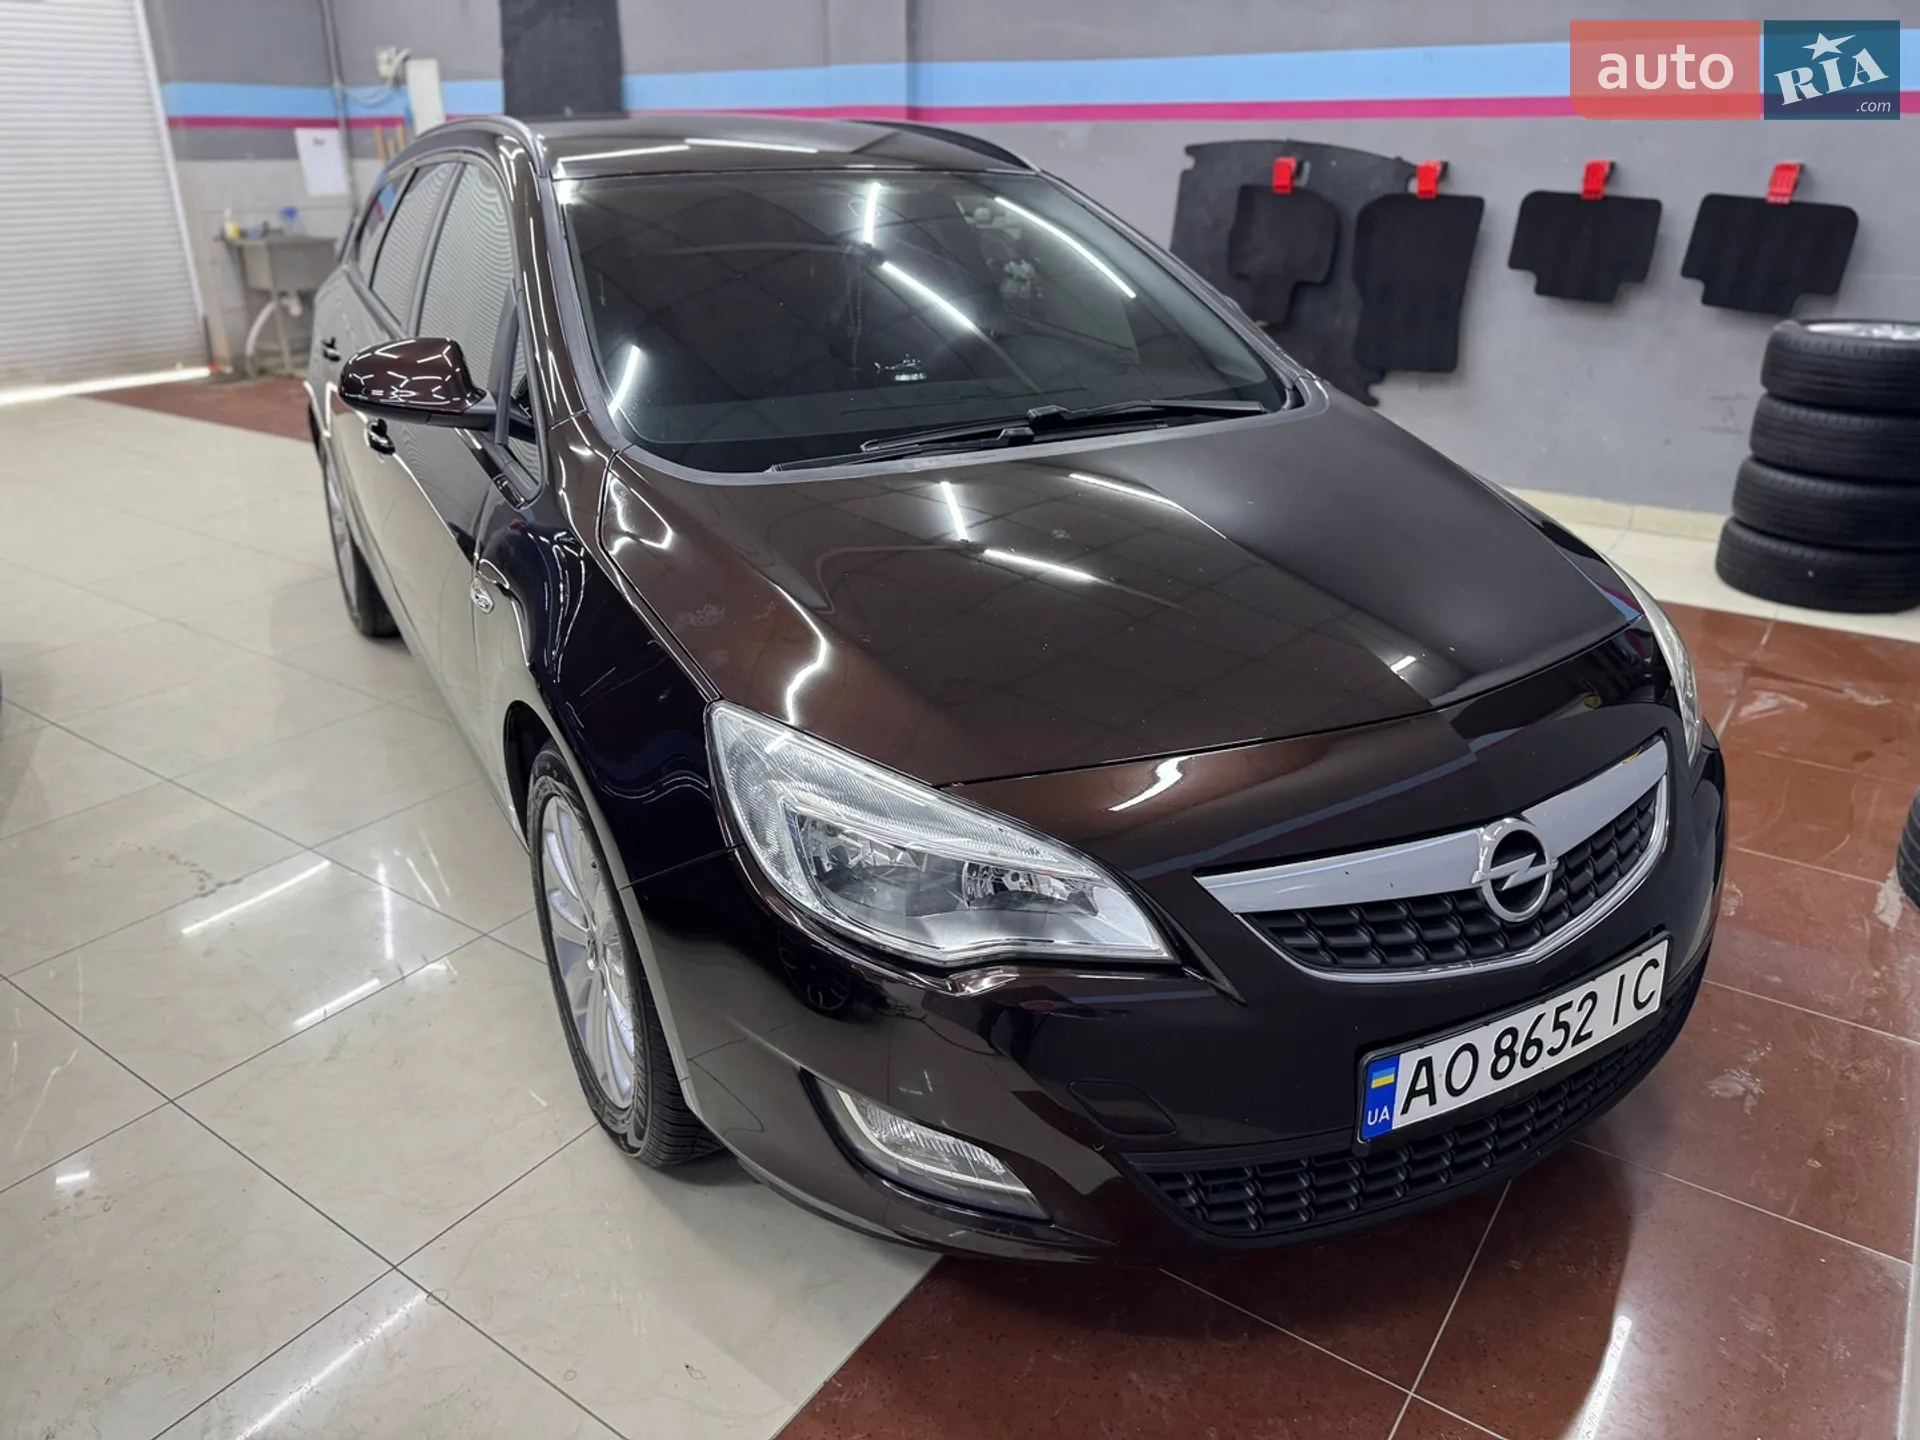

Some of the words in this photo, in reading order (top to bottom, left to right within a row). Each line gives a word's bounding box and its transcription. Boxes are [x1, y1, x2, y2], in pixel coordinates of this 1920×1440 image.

[1400, 1043, 1479, 1115] AO
[1490, 990, 1598, 1081] 8652
[1612, 957, 1660, 1026] IC
[1366, 1105, 1390, 1126] UA
